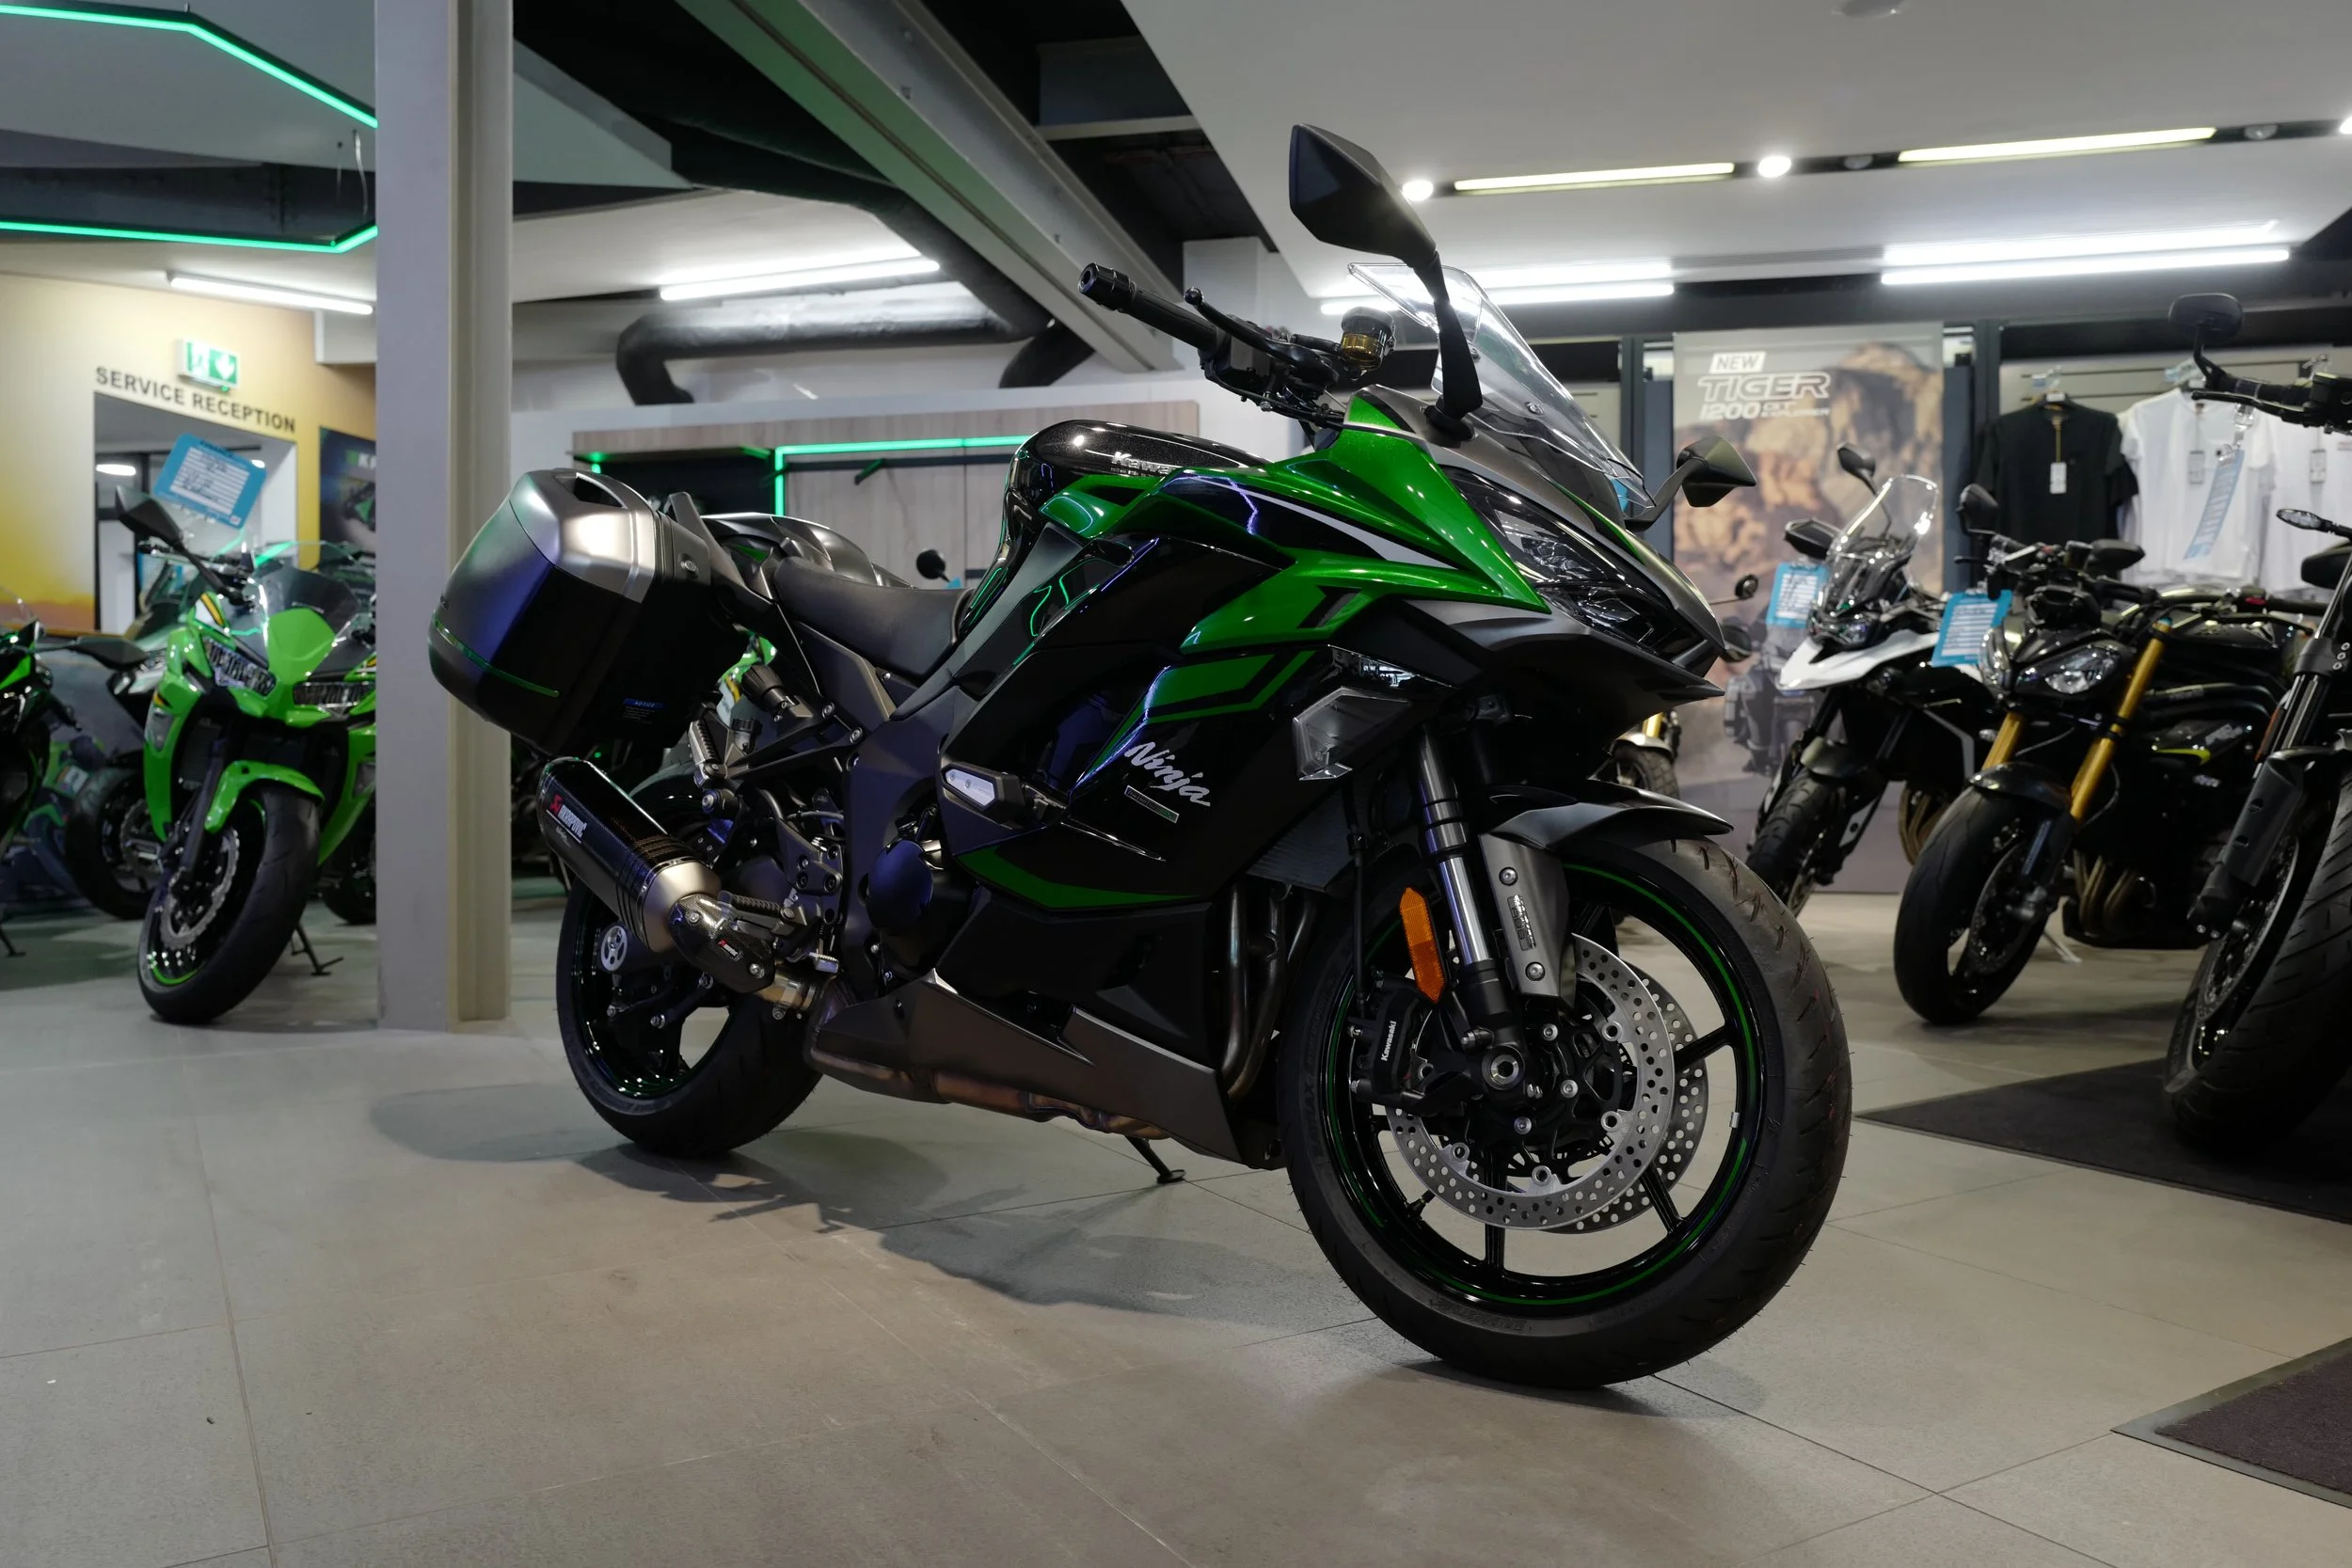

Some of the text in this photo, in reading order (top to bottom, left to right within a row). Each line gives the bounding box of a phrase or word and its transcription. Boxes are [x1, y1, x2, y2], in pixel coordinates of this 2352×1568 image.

[1715, 354, 1759, 371] NEW
[96, 366, 296, 435] SERVICE RECEPTION
[1697, 372, 1832, 403] TIGER
[1699, 402, 1761, 421] 1200
[1124, 741, 1211, 807] Ninja
[1380, 1020, 1397, 1062] Kawasaki
